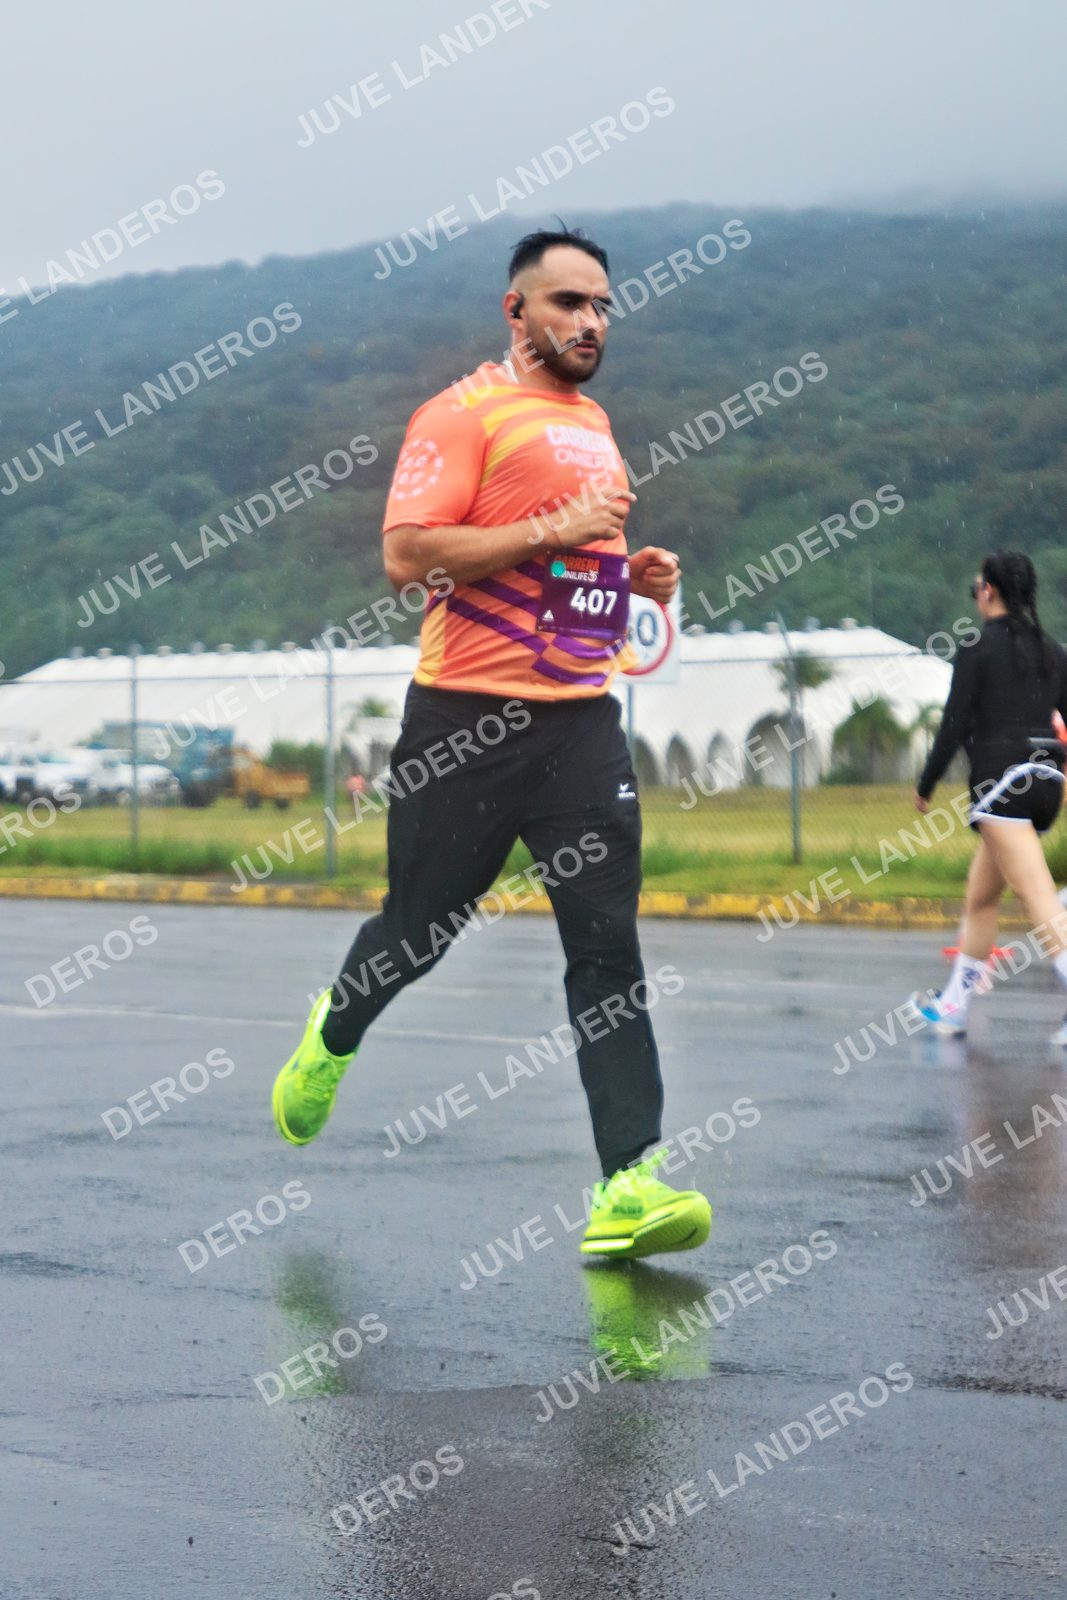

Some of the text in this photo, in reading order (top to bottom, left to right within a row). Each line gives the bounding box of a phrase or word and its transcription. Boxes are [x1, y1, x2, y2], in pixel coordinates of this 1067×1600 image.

[552, 571, 588, 581] MNILIFE
[570, 587, 618, 615] 407
[628, 610, 657, 647] 0
